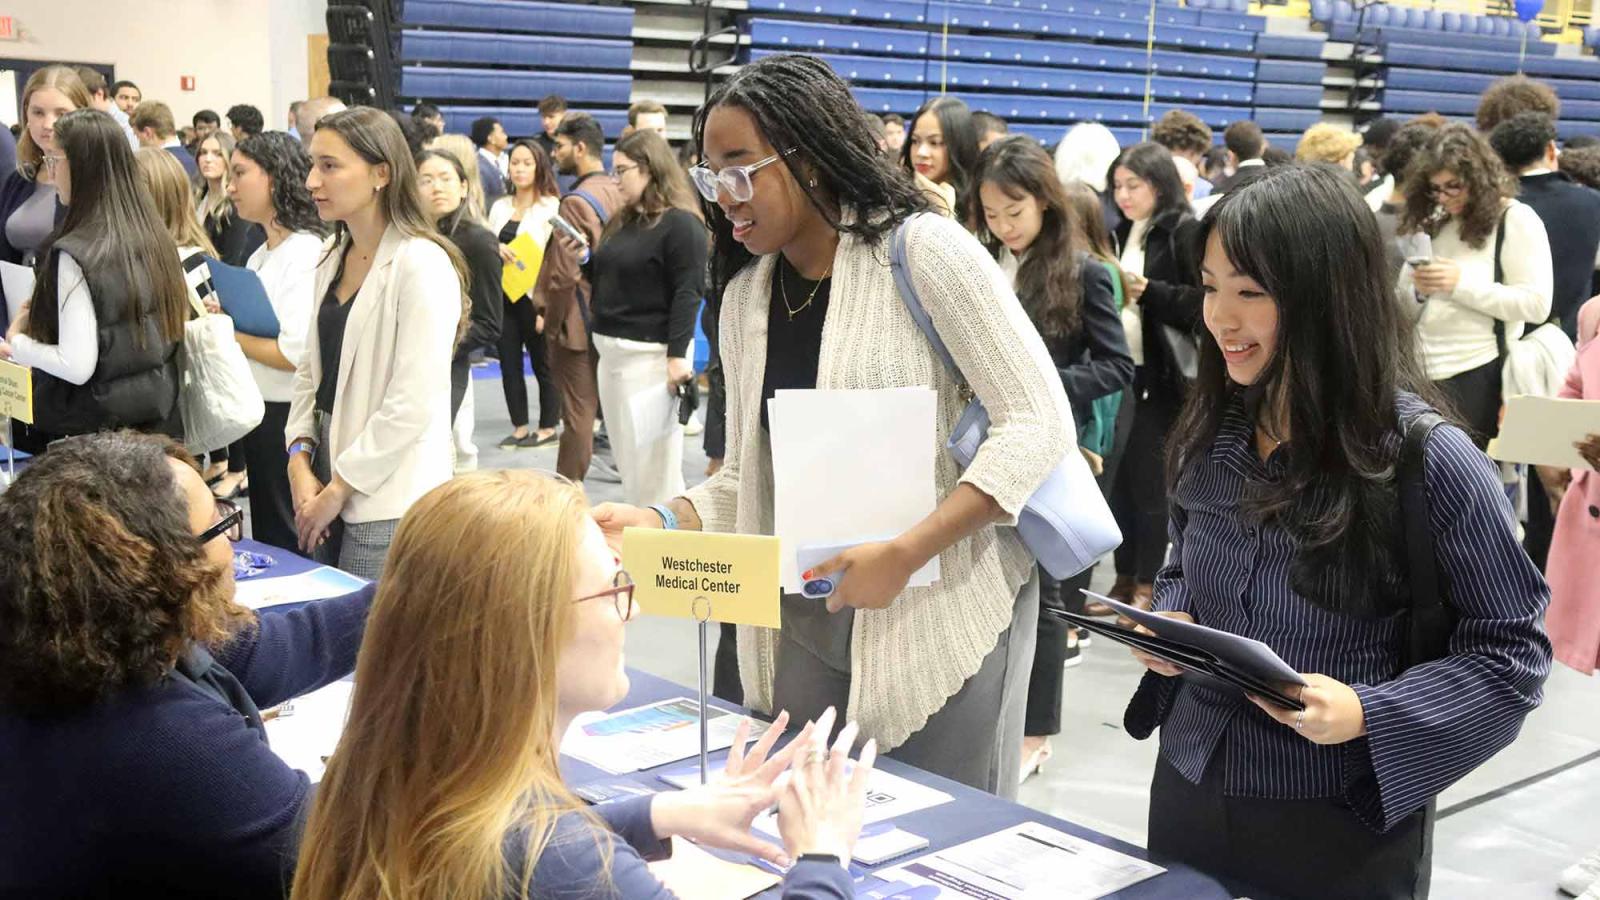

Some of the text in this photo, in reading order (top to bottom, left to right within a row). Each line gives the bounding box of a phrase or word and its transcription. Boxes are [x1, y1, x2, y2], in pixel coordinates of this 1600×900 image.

[662, 556, 732, 573] Westchester
[656, 574, 740, 593] Medical Center
